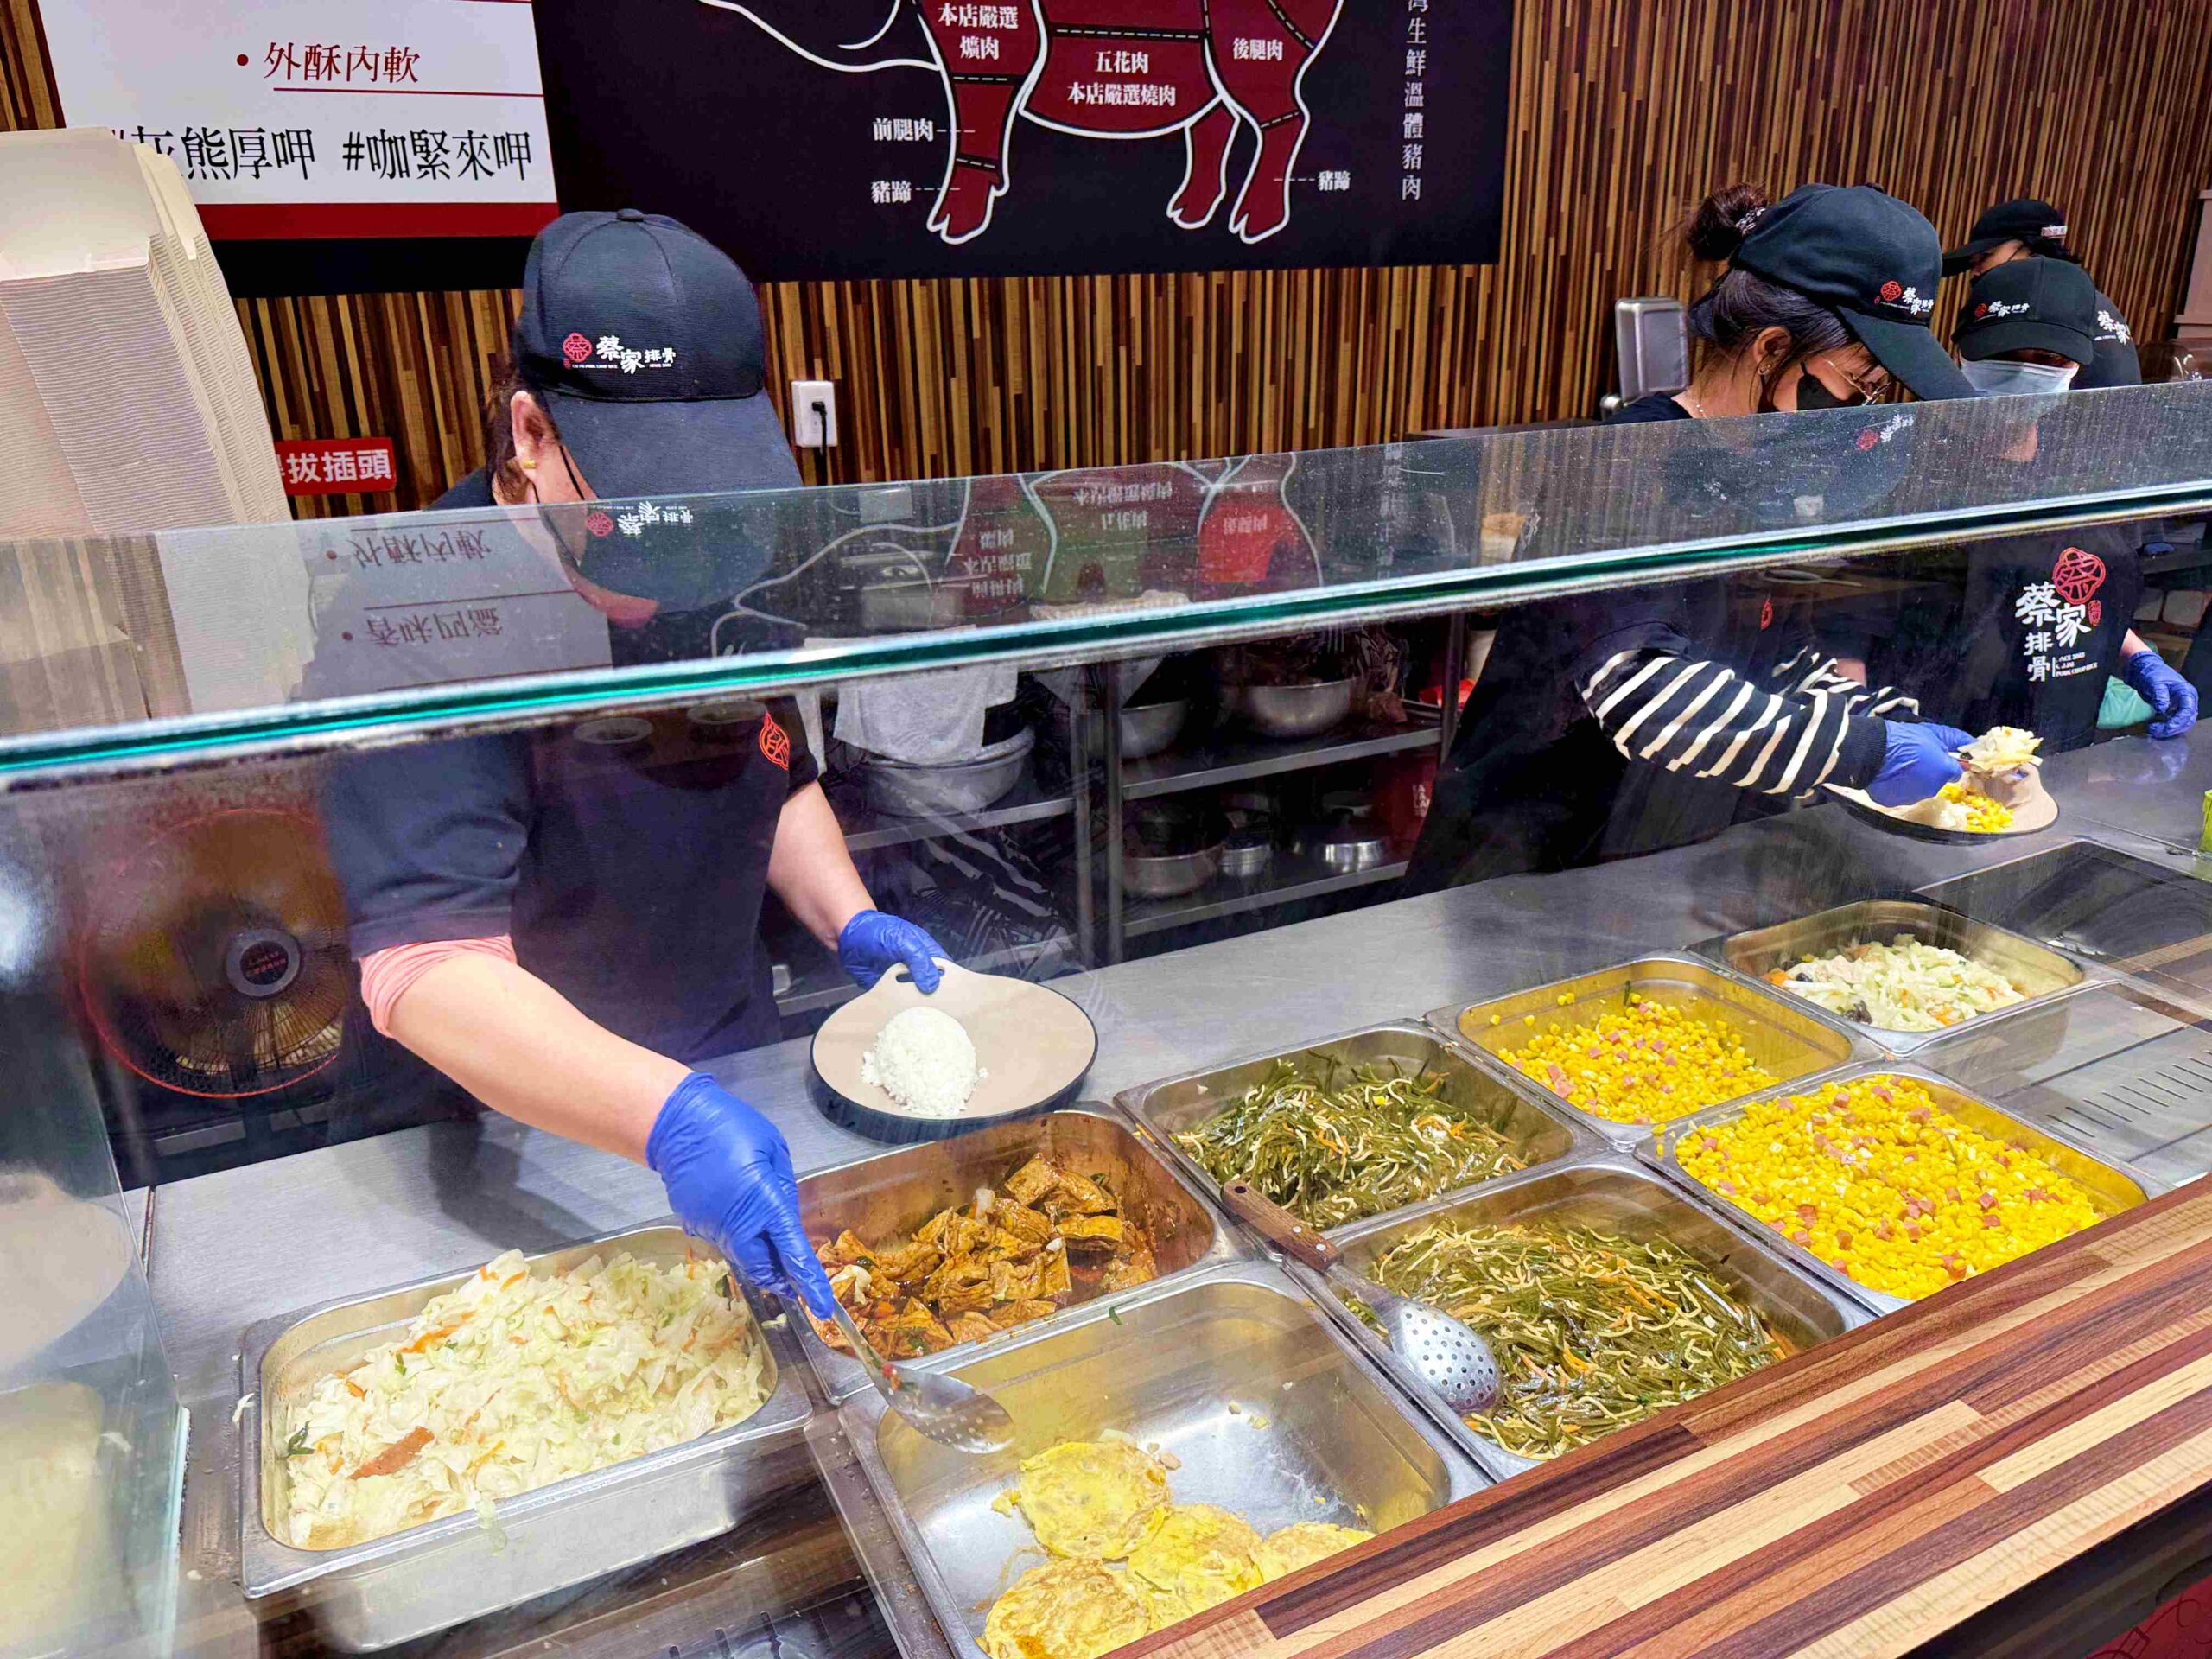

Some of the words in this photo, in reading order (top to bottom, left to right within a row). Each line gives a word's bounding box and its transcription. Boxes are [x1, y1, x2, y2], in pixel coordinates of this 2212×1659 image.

[938, 3, 1019, 29] 本店嚴選
[1095, 50, 1148, 74] 五花肉
[1232, 38, 1283, 61] 後腿肉
[263, 41, 421, 84] 外酥內軟
[1067, 81, 1176, 106] 本店嚴選燒肉
[872, 118, 934, 142] 前腿肉
[342, 127, 532, 181] #咖緊來呷
[870, 180, 912, 204] 豬蹄
[1317, 169, 1351, 191] 豬蹄
[2097, 309, 2131, 346] 蔡家
[596, 334, 677, 375] 蔡家排骨
[276, 448, 392, 484] 拔插頭
